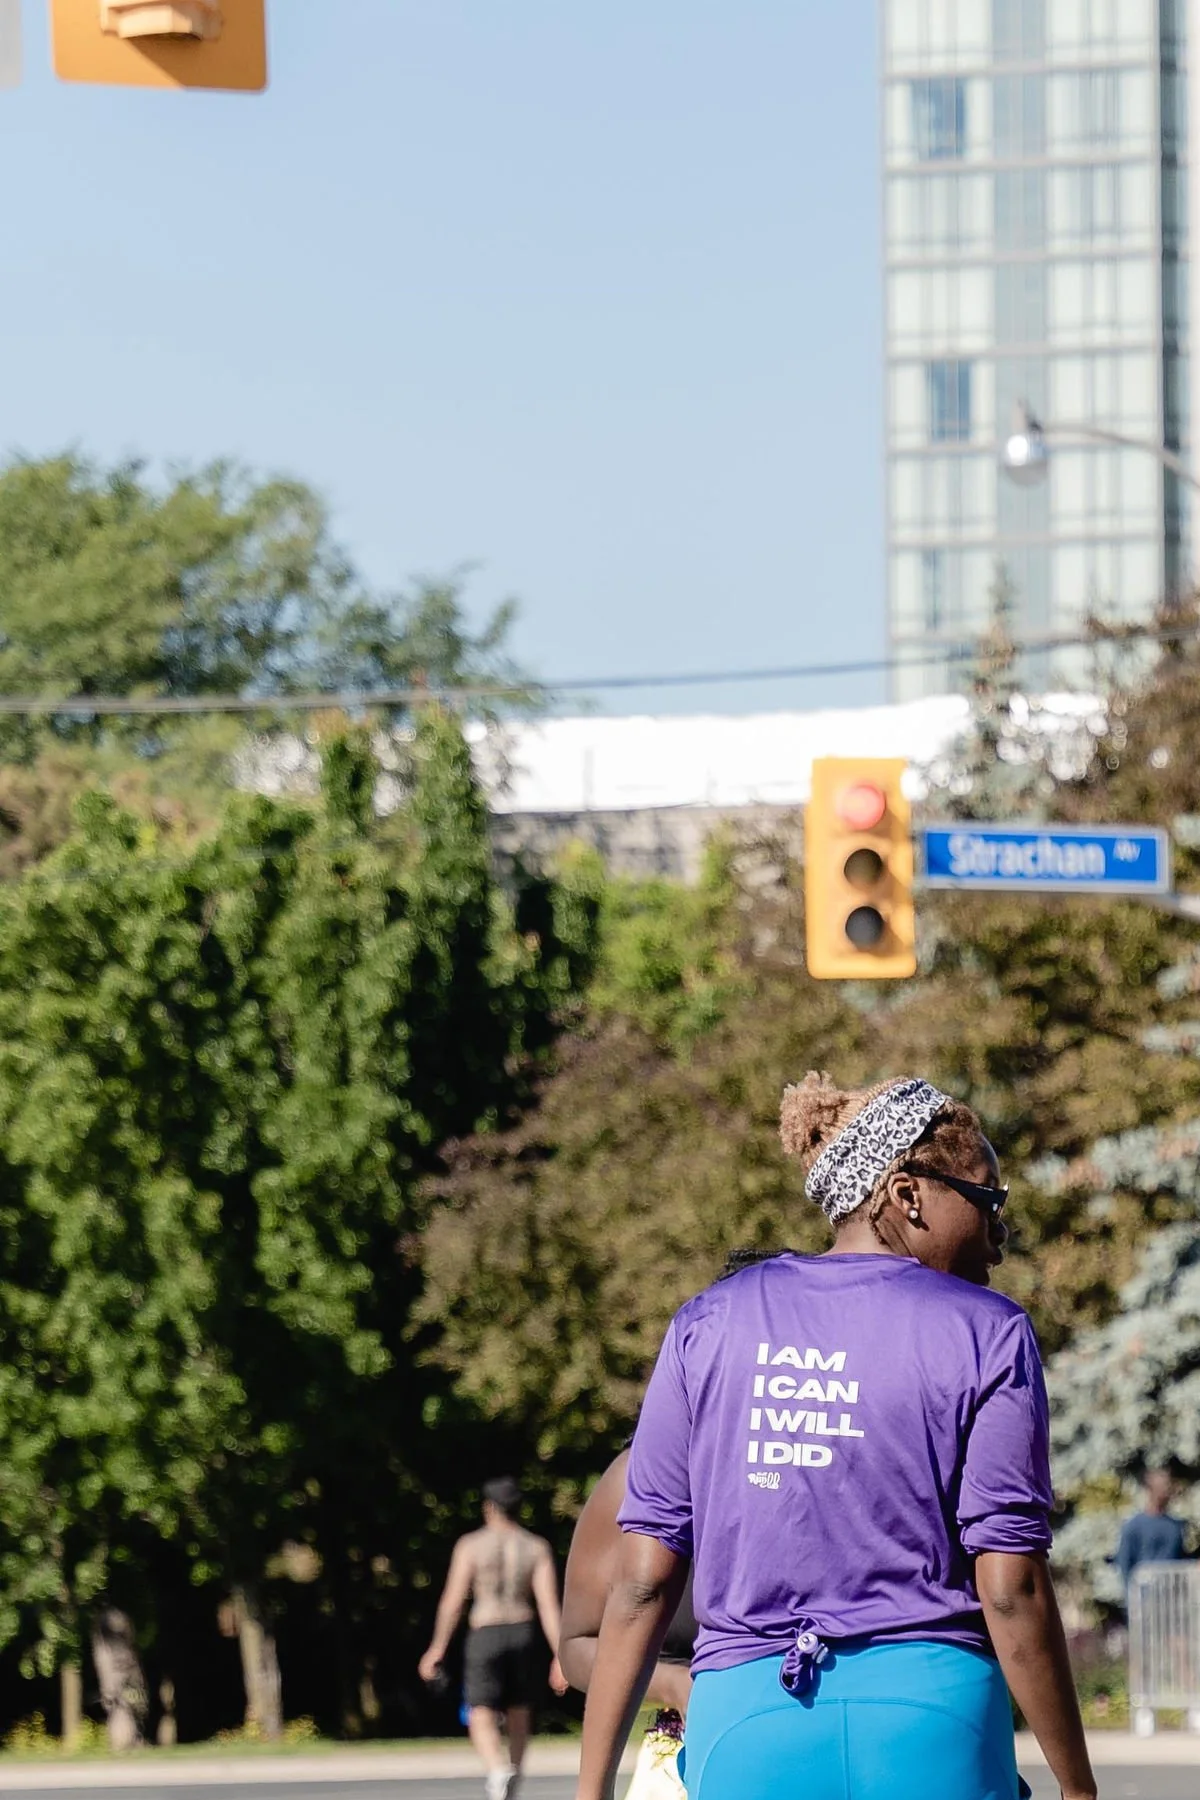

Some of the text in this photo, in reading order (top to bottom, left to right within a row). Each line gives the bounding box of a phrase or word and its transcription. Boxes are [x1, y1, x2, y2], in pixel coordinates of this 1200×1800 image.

[947, 834, 1106, 878] Strachan
[757, 1342, 847, 1372] I AM
[753, 1374, 859, 1404] I CAN
[750, 1407, 865, 1438] I WILL
[747, 1440, 833, 1467] I DID
